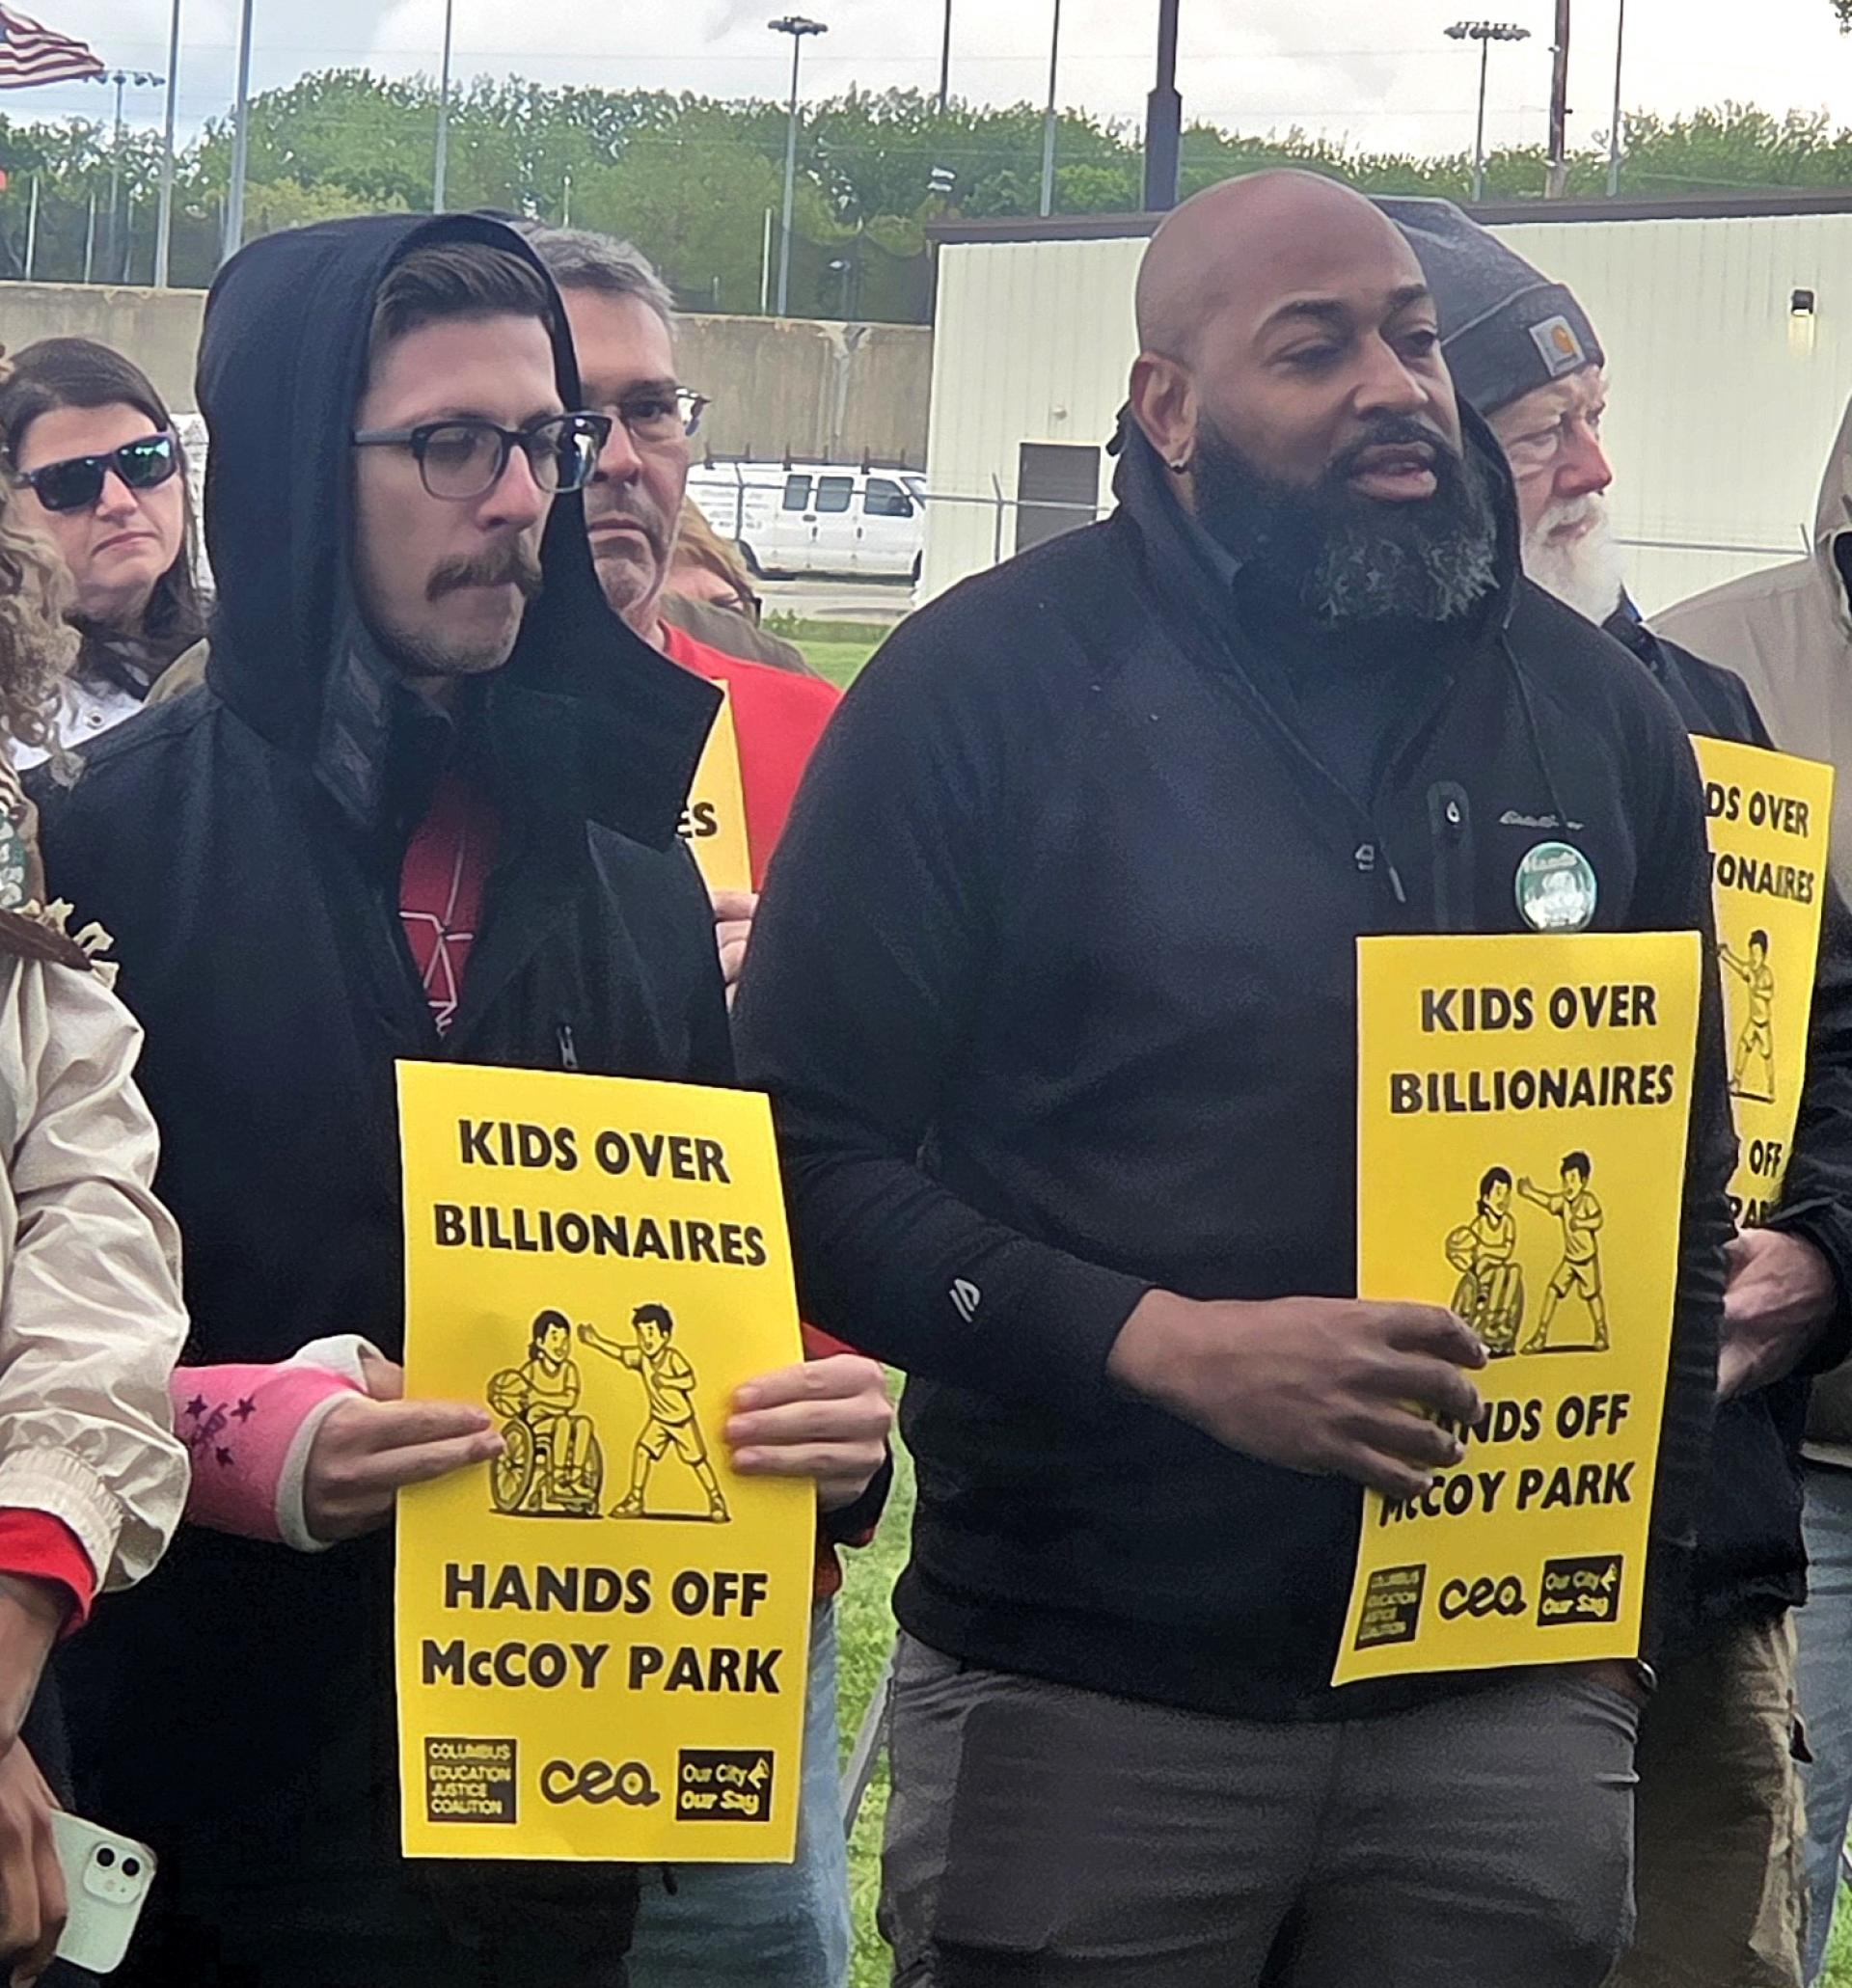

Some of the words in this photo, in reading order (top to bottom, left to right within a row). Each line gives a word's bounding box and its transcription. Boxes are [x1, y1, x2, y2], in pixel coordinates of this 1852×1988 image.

[1749, 791, 1809, 838] OVER
[1423, 989, 1532, 1031] KIDS
[1550, 986, 1656, 1028] OVER
[1392, 1065, 1674, 1114] BILLIONAIRES
[459, 1120, 578, 1171] KIDS
[595, 1131, 730, 1184] OVER
[1750, 1139, 1783, 1177] OFF
[434, 1204, 766, 1266] BILLIONAIRES
[1556, 1394, 1630, 1438] OFF
[1515, 1461, 1635, 1511] PARK
[445, 1563, 651, 1614] HANDS
[671, 1570, 768, 1618] OFF
[422, 1640, 610, 1689] McCOY
[628, 1646, 782, 1694] PARK
